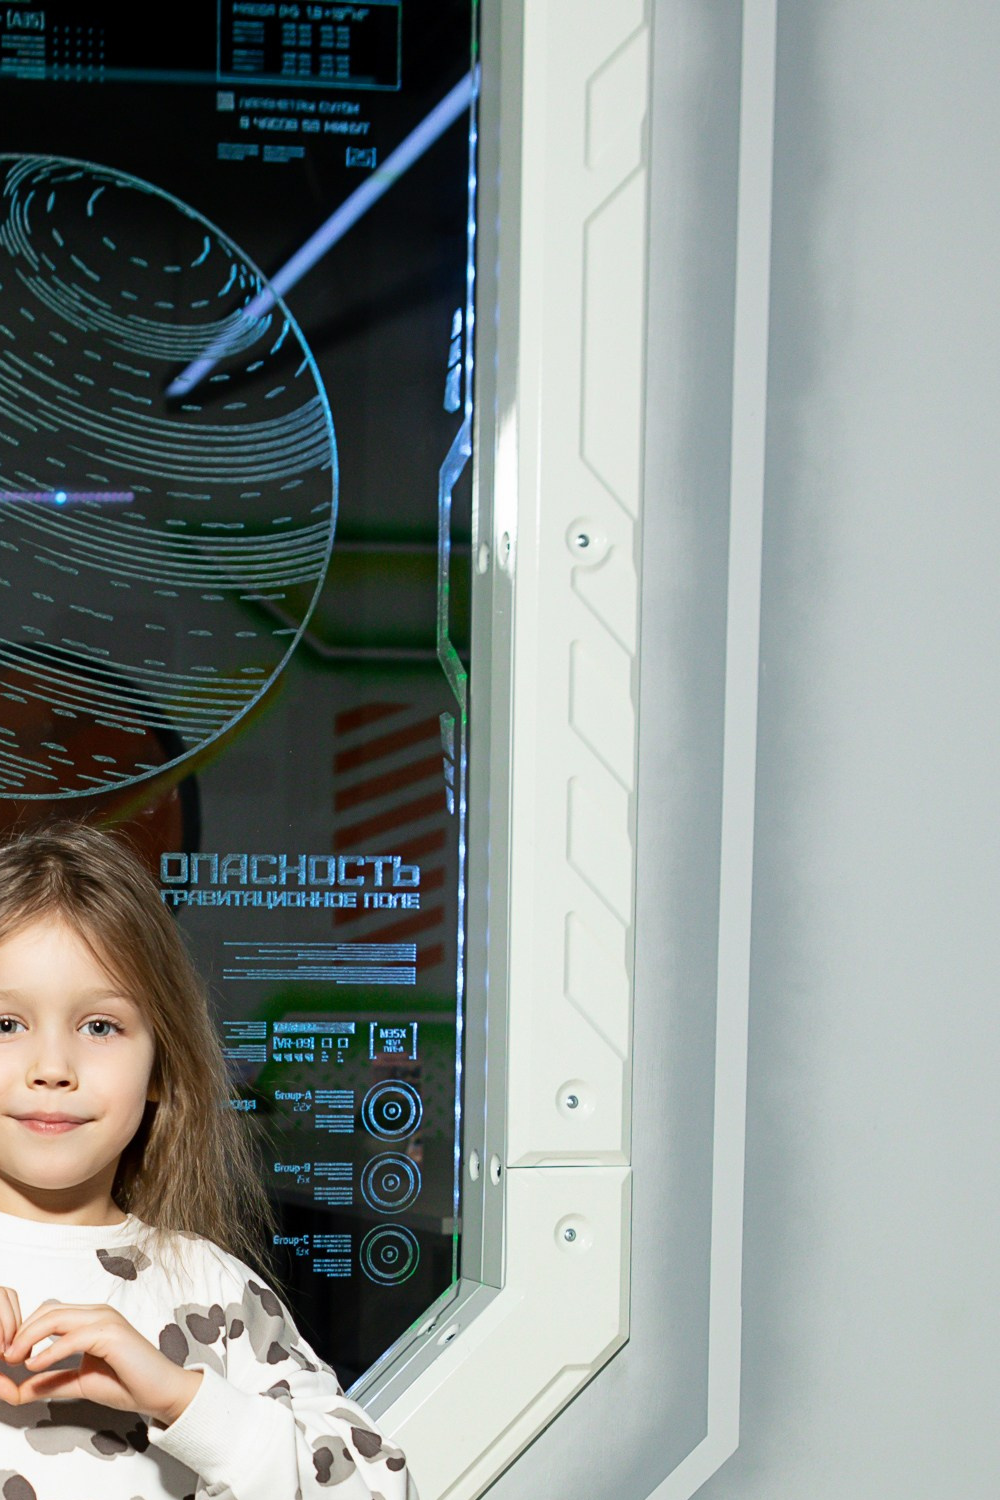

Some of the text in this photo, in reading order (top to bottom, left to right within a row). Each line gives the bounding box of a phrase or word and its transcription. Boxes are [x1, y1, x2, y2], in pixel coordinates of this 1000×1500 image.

[160, 852, 421, 888] ОПАСНОСТЬ
[160, 888, 422, 910] ГРАВИТАЦИОННОЕ ПОЛЕ
[274, 1089, 312, 1101] Group-A
